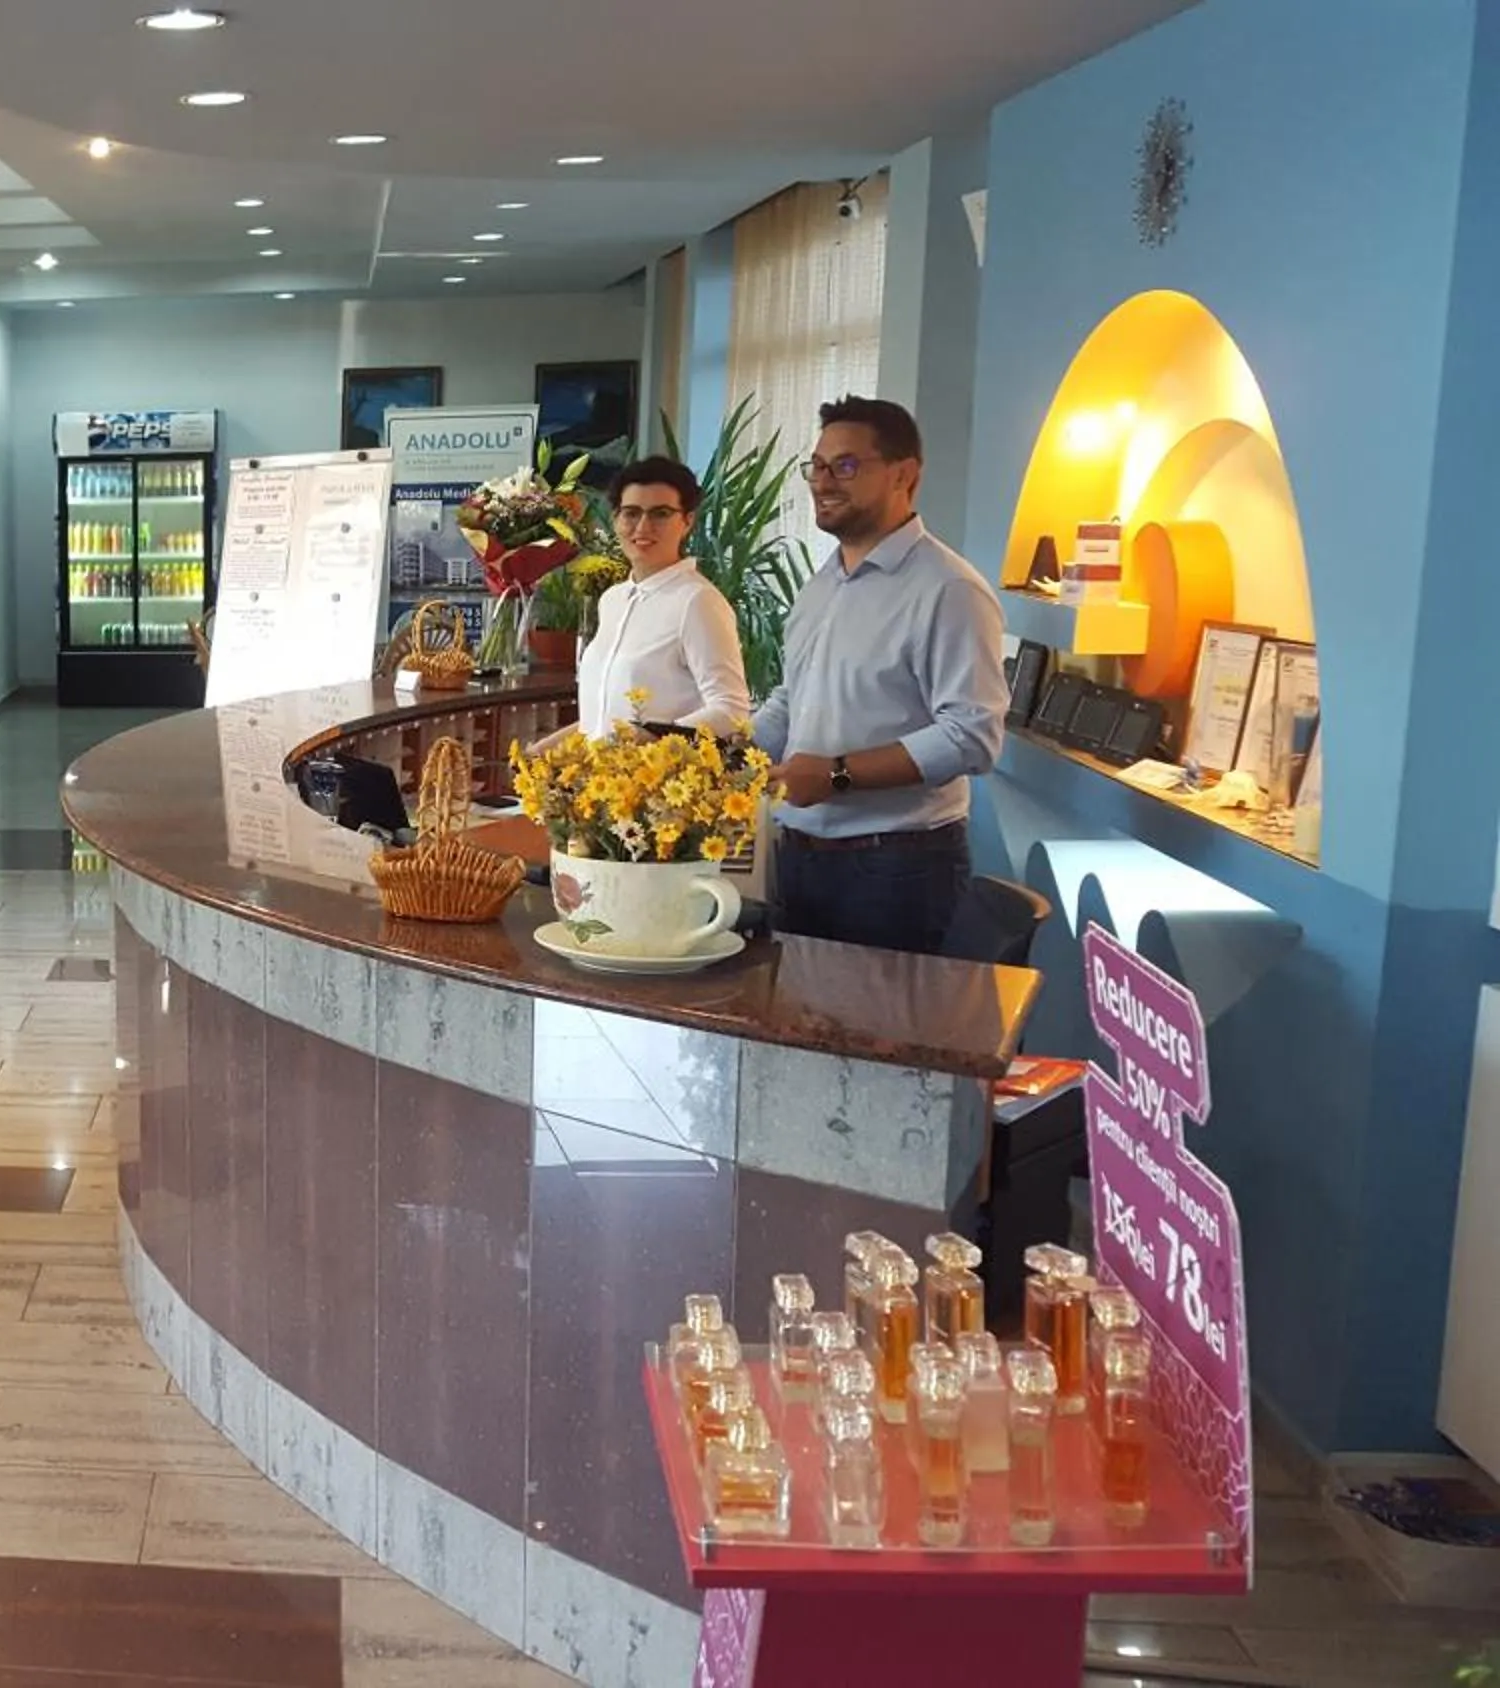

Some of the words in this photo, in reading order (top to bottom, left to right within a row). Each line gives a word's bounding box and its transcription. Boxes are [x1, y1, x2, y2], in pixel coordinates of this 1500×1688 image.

[111, 423, 171, 439] PEPS
[405, 431, 510, 450] ANADOLU
[395, 487, 441, 499] Anadolu
[1093, 955, 1193, 1079] Reducere
[1126, 1057, 1171, 1139] 50%
[1096, 1106, 1135, 1160] pentru
